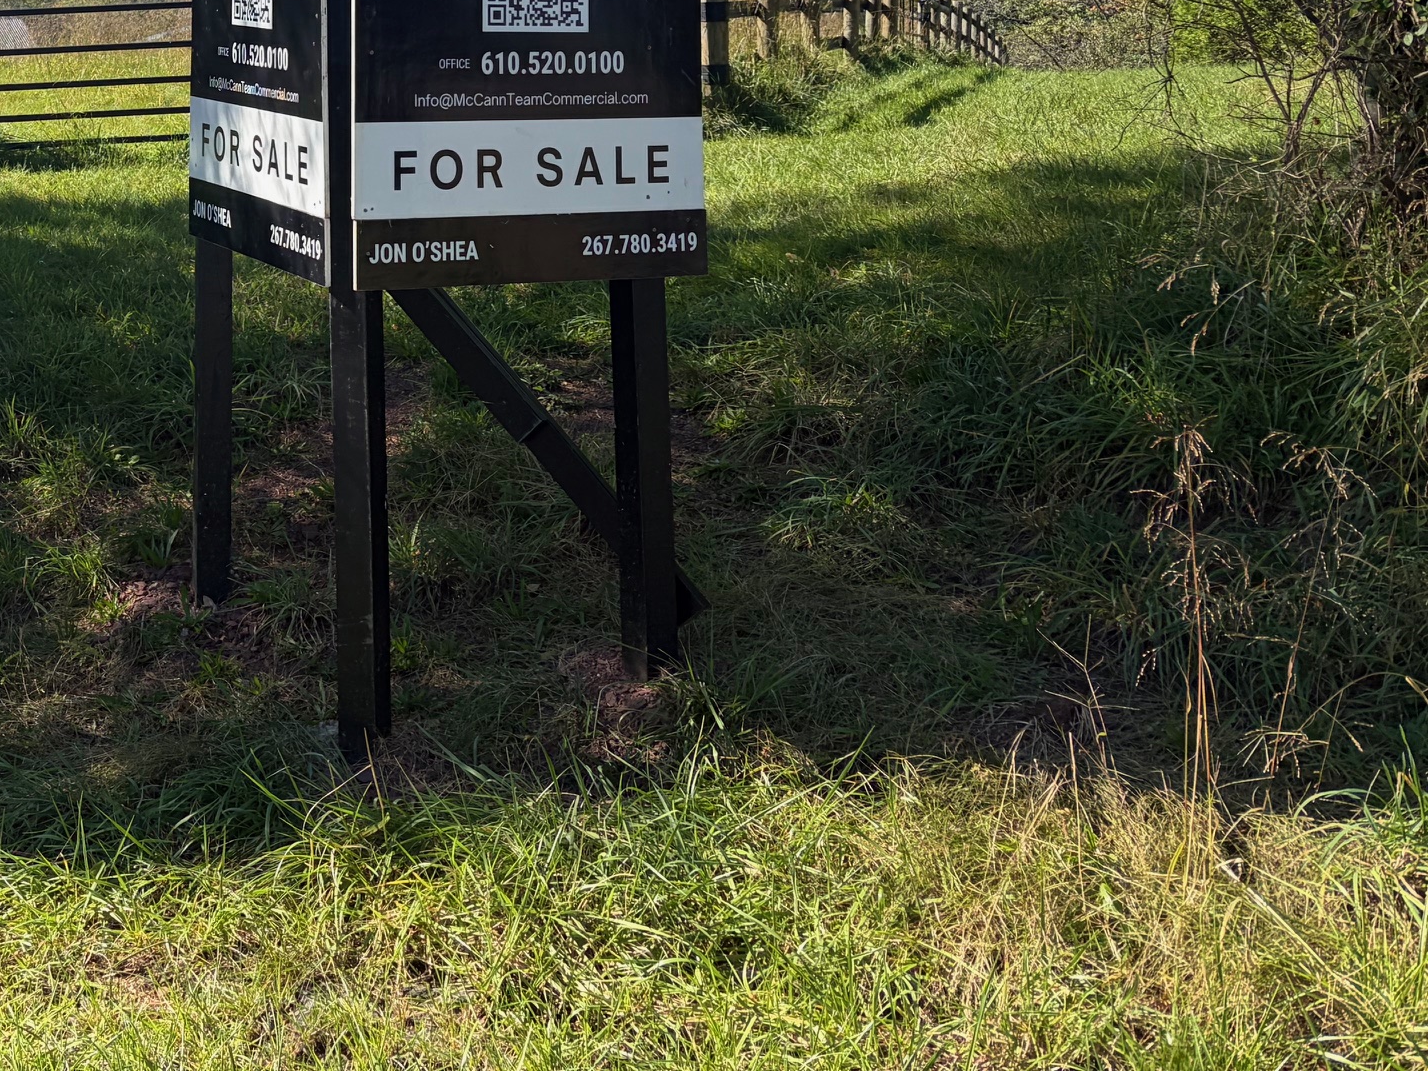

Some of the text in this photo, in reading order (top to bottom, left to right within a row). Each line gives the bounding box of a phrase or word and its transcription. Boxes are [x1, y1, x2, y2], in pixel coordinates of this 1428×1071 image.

[231, 42, 289, 71] 610.520.0100
[438, 50, 625, 76] OFFICE 610.520.0100
[413, 92, 649, 111] Info@McCannTeamCommercial.com
[201, 122, 308, 186] FOR SALE
[393, 145, 670, 191] FOR SALE
[192, 199, 232, 229] JON O'SHEA
[269, 224, 322, 260] 267.780.3419
[368, 240, 479, 265] JON O'SHEA
[581, 232, 698, 257] 267.780.3419
